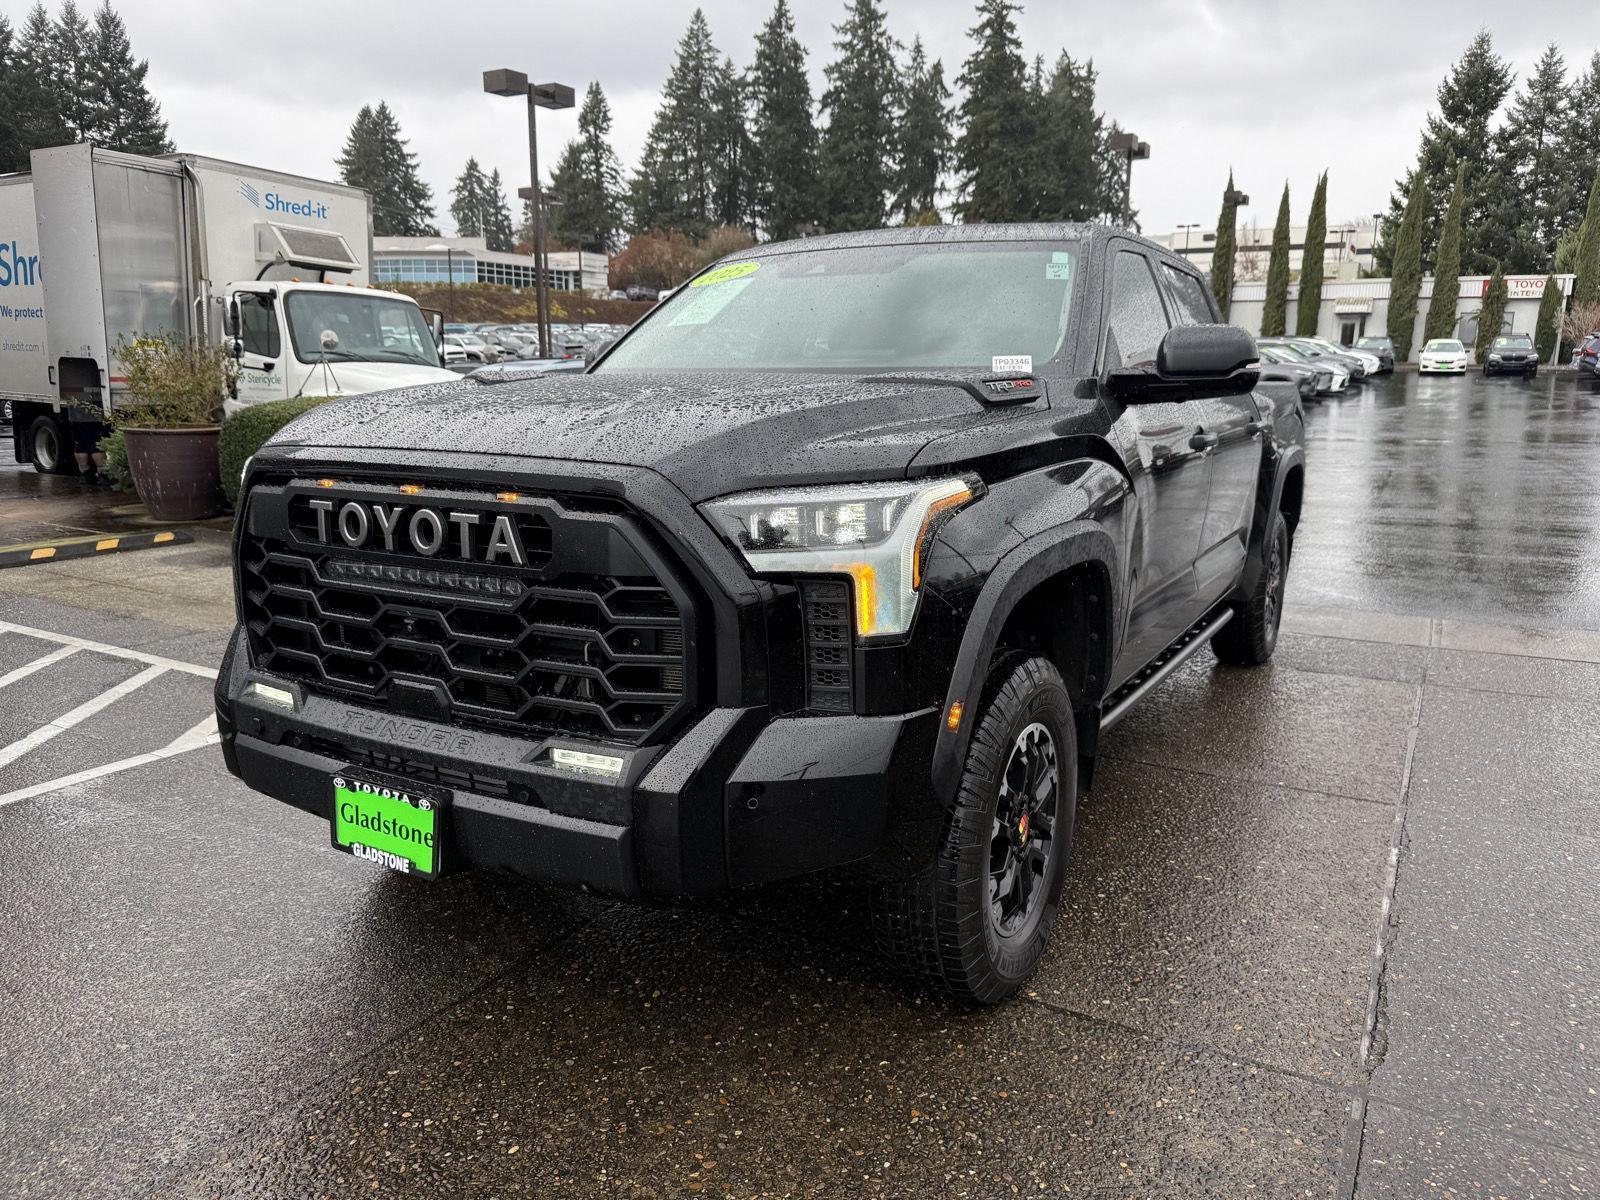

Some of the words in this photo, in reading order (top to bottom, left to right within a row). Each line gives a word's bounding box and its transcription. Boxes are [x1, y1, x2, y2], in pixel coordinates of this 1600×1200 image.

[265, 193, 327, 219] Shred-it
[0, 240, 43, 287] Shr
[1514, 280, 1547, 289] TOYO
[0, 305, 13, 317] We
[14, 307, 44, 321] protect
[2, 340, 40, 352] shredit.com
[993, 358, 1030, 366] TP03346
[247, 372, 282, 387] Stericycle
[309, 499, 527, 567] TOYOTA
[343, 710, 477, 757] TUNDRA
[353, 781, 411, 804] TOYOTA
[340, 802, 434, 849] Gladstone
[352, 842, 410, 874] GLADSTONE
